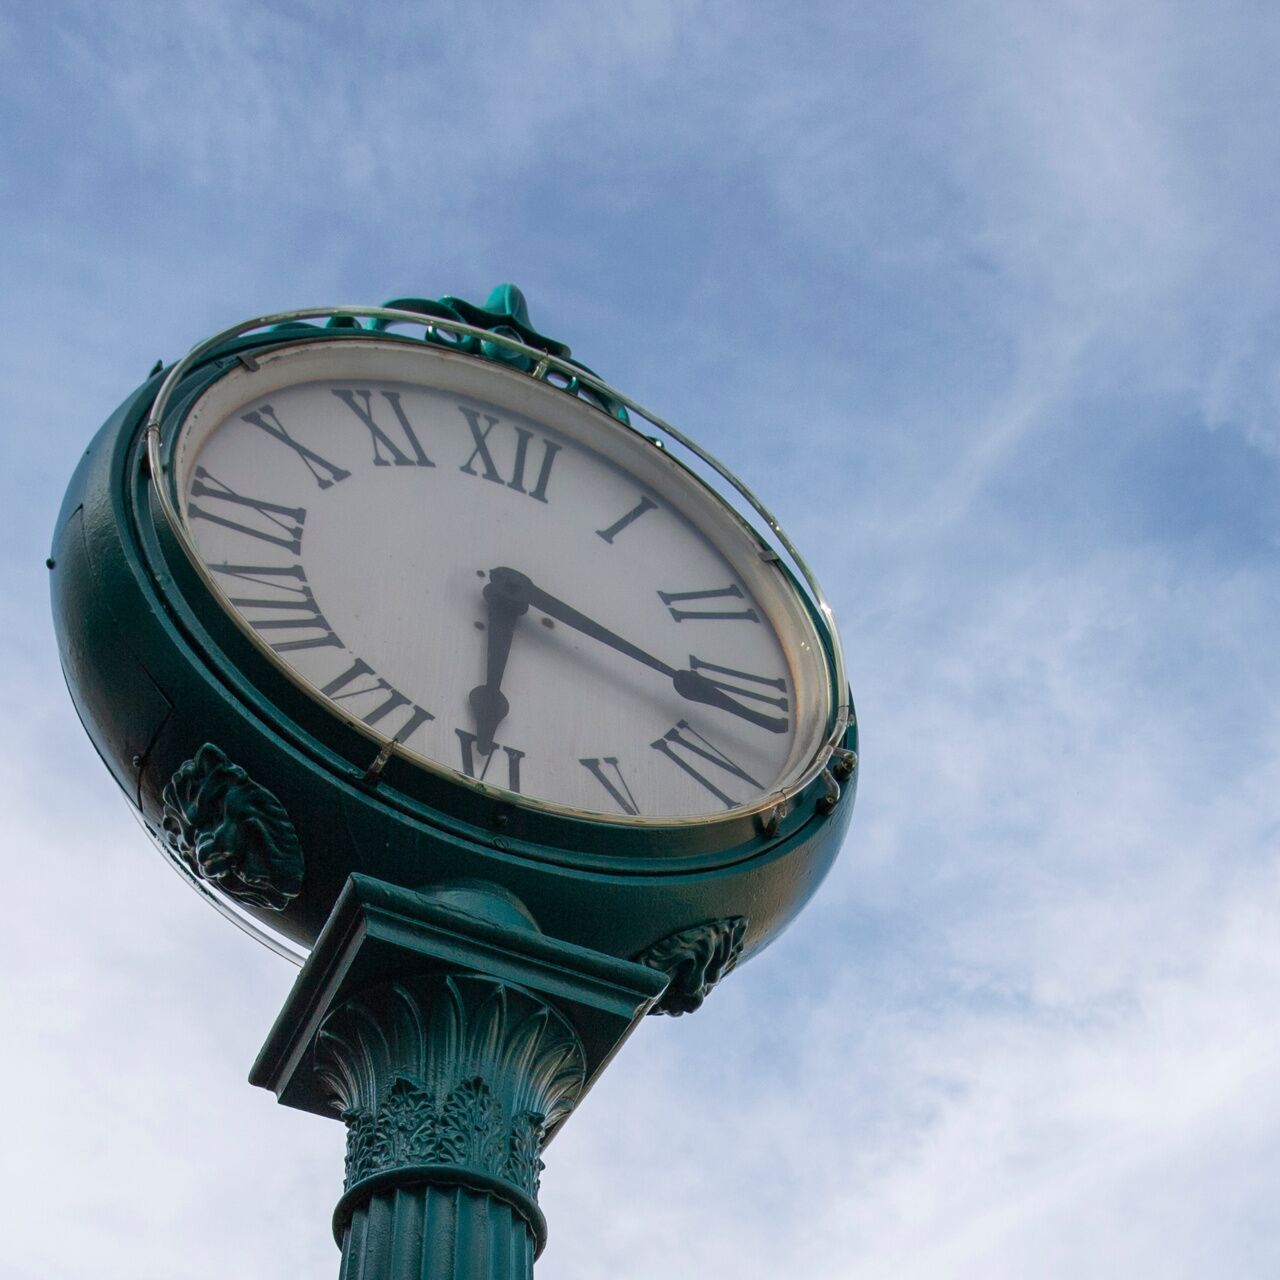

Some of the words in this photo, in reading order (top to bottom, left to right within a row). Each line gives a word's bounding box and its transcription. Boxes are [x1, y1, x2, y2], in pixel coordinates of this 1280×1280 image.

[240, 404, 353, 490] X
[331, 389, 436, 467] XI
[457, 405, 563, 504] XII
[595, 495, 659, 545] I
[656, 583, 761, 624] II
[578, 756, 641, 815] V
